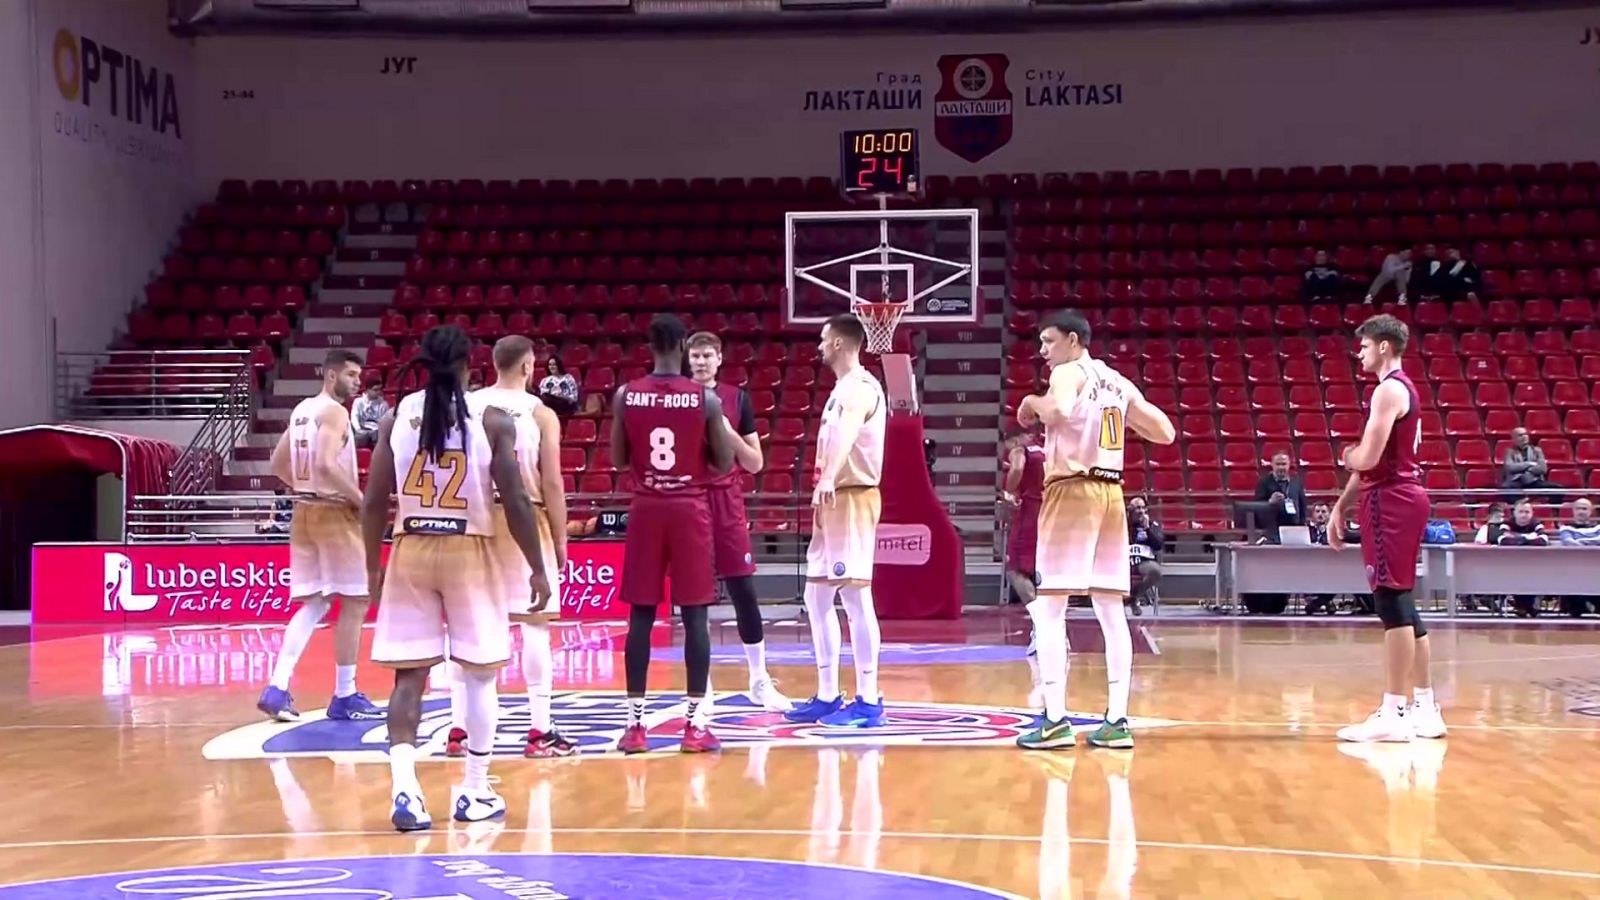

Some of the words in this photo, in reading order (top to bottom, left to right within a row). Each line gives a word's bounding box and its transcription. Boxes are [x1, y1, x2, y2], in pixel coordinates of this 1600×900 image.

[53, 27, 182, 140] OPTIMA
[876, 71, 922, 84] Град
[1025, 68, 1066, 84] City
[803, 88, 922, 112] ЛАКТАШИ
[854, 131, 912, 154] 10:00
[857, 156, 902, 187] 24
[625, 391, 700, 409] SANT-ROOS
[649, 426, 676, 471] 8
[402, 449, 468, 509] 42
[408, 517, 459, 531] OPTIMA
[144, 560, 293, 589] lubelskie
[163, 590, 232, 617] Taste
[240, 587, 293, 617] life!
